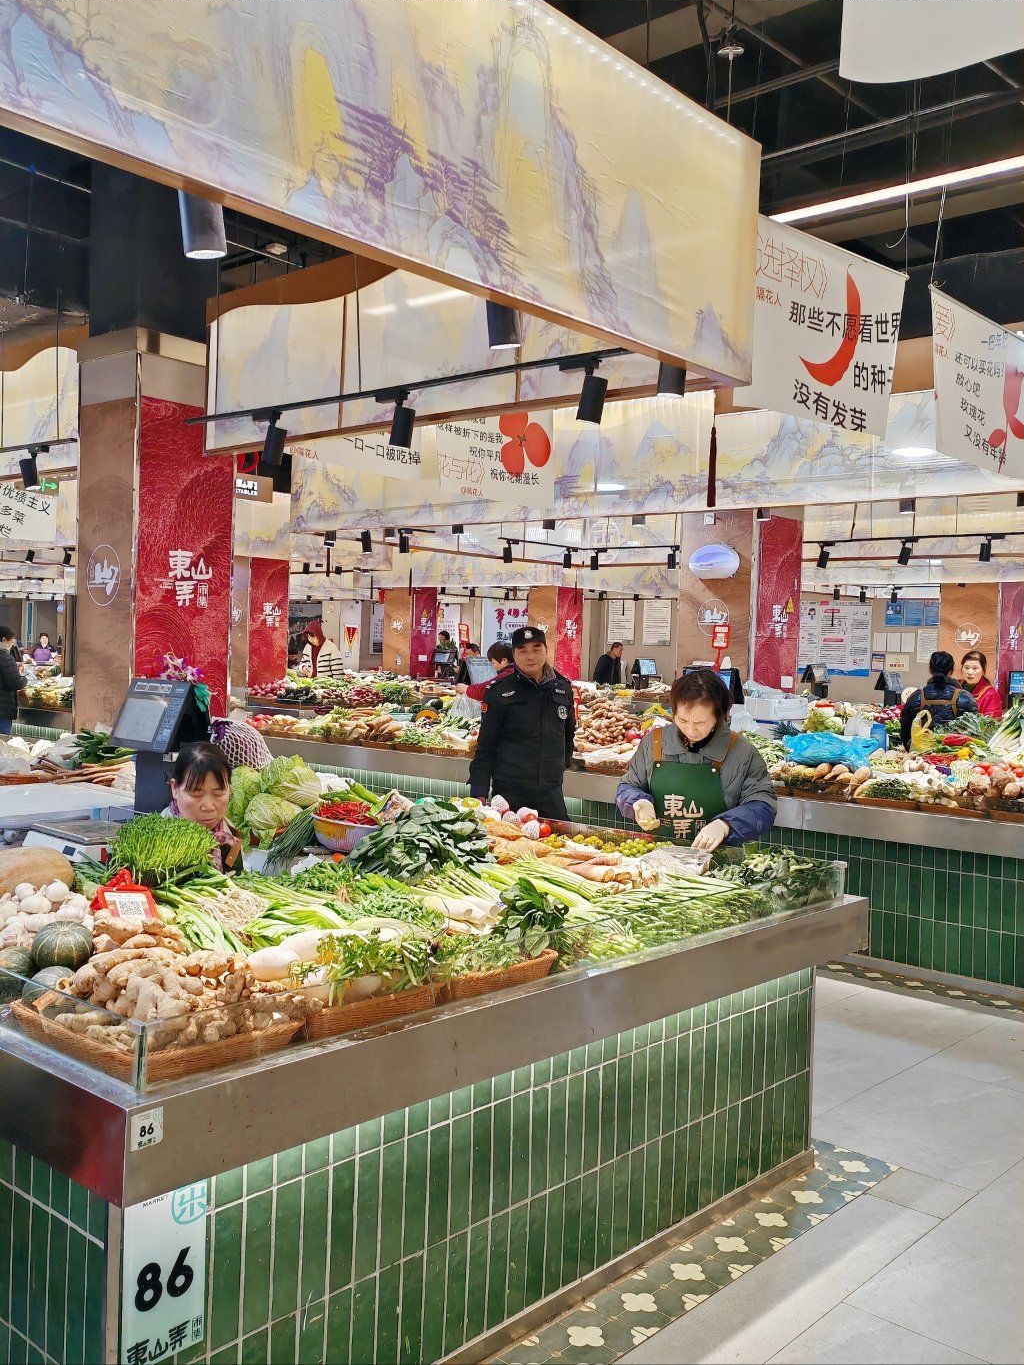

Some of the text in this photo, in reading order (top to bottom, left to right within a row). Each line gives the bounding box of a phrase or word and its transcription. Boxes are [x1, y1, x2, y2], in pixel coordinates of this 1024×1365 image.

[955, 372, 981, 398] 放心吧
[792, 378, 867, 433] 没有发芽
[960, 397, 986, 427] 玫瑰花
[342, 436, 422, 466] 一口一口被吃掉
[168, 549, 213, 580] 東山
[663, 793, 704, 819] 東山
[139, 1122, 154, 1138] 86
[134, 1245, 194, 1313] 86
